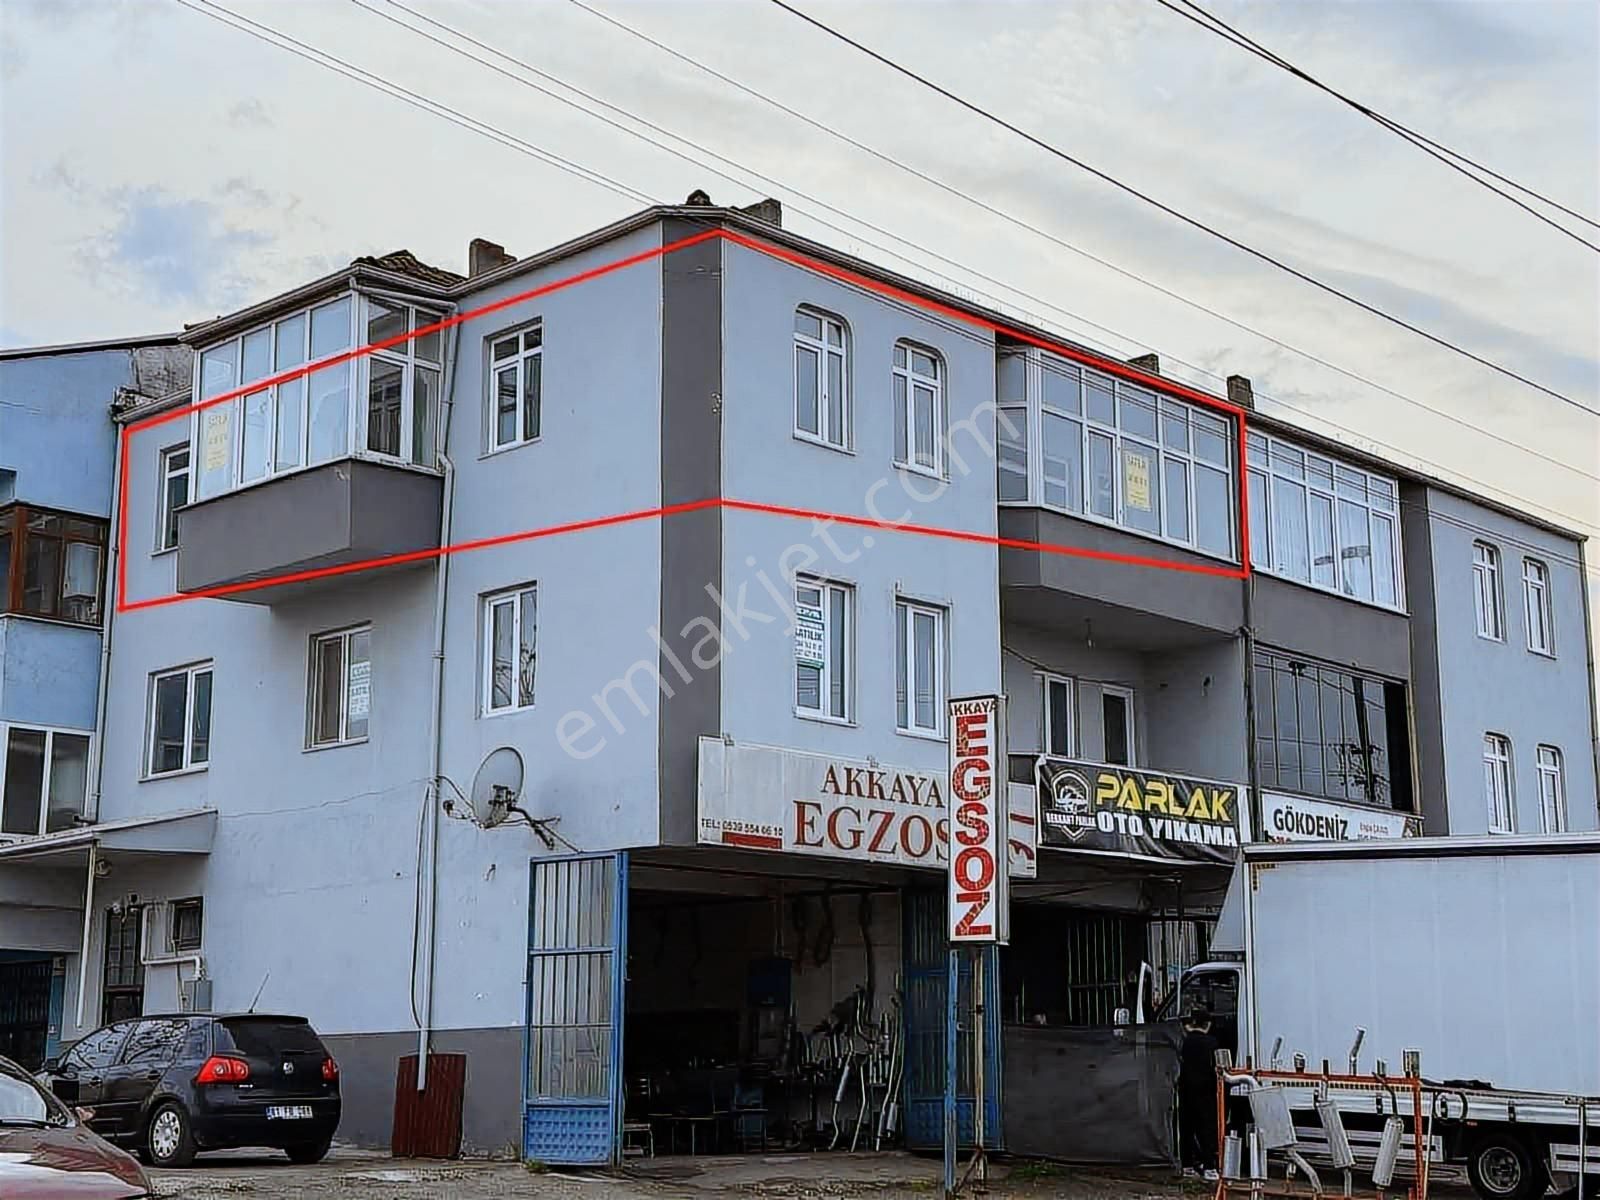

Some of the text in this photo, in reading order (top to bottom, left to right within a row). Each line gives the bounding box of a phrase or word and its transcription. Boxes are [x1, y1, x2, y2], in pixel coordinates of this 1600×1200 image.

[821, 765, 945, 808] AKKAYA
[1096, 774, 1232, 821] PARLAK
[702, 818, 720, 829] TEL:
[952, 715, 994, 936] EGSOZ
[1097, 811, 1238, 847] OTO YIKAMA
[1273, 805, 1349, 840] GÖKDENİZ
